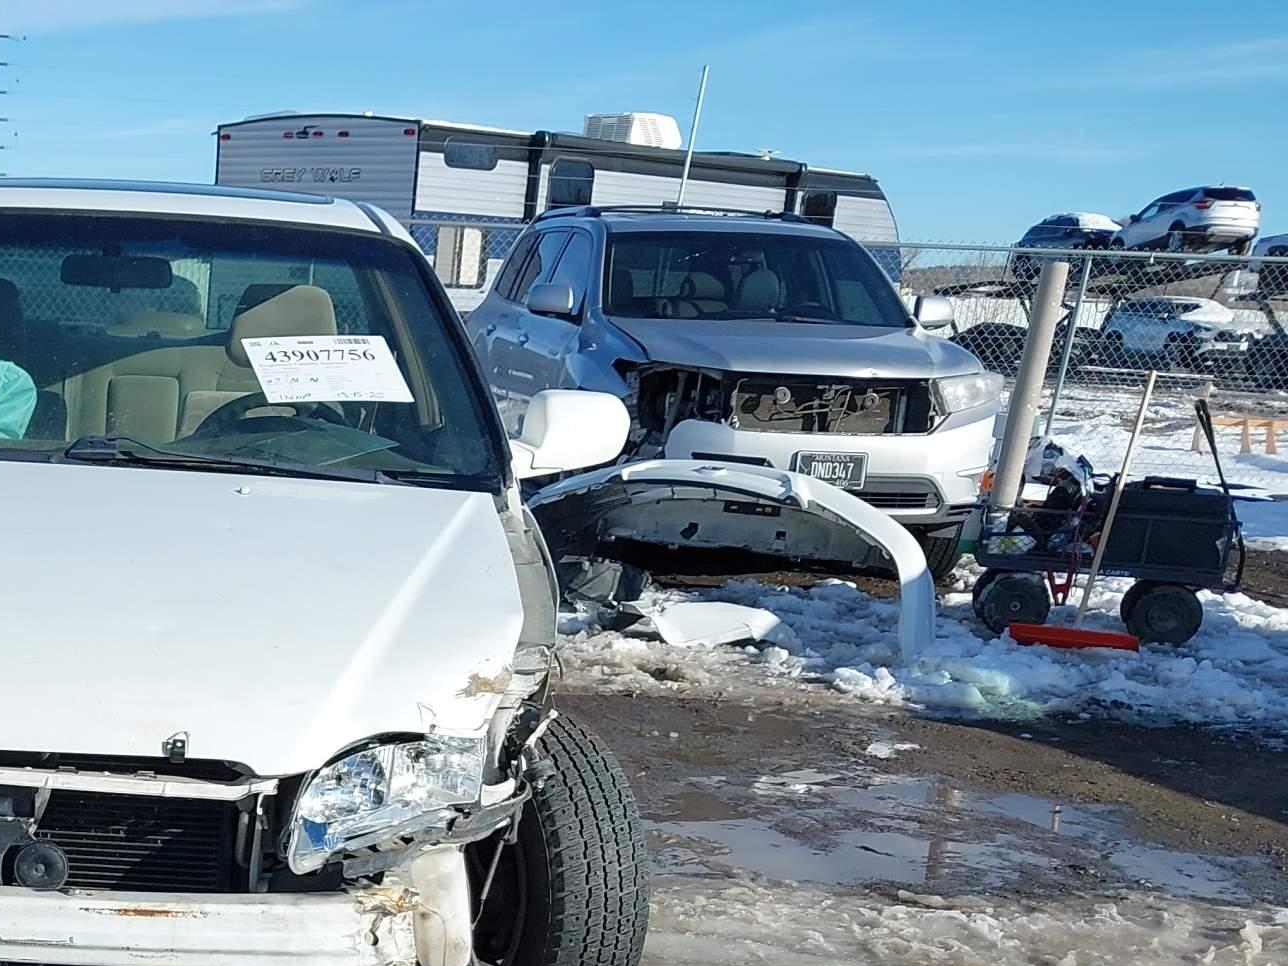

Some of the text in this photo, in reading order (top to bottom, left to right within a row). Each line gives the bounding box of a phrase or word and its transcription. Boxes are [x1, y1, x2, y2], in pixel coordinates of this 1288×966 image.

[261, 167, 307, 183] GREY
[264, 349, 376, 363] 43907756
[814, 454, 851, 462] MONTANA
[811, 461, 854, 479] DND347
